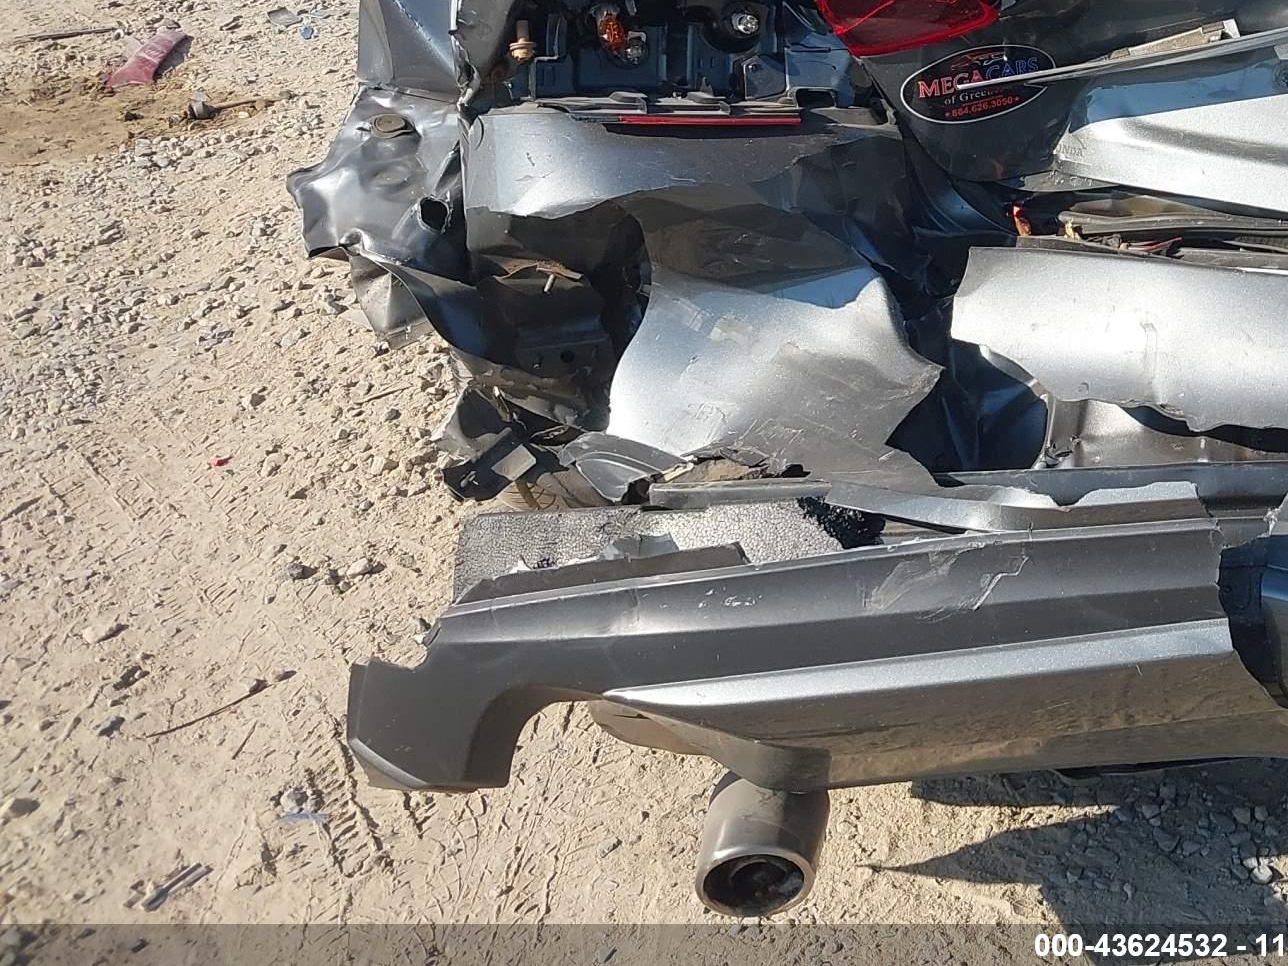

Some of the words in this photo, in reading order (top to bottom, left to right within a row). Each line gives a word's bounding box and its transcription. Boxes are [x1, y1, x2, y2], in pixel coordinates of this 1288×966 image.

[918, 69, 984, 98] MEGA
[985, 56, 1039, 80] CARS
[944, 94, 956, 105] of
